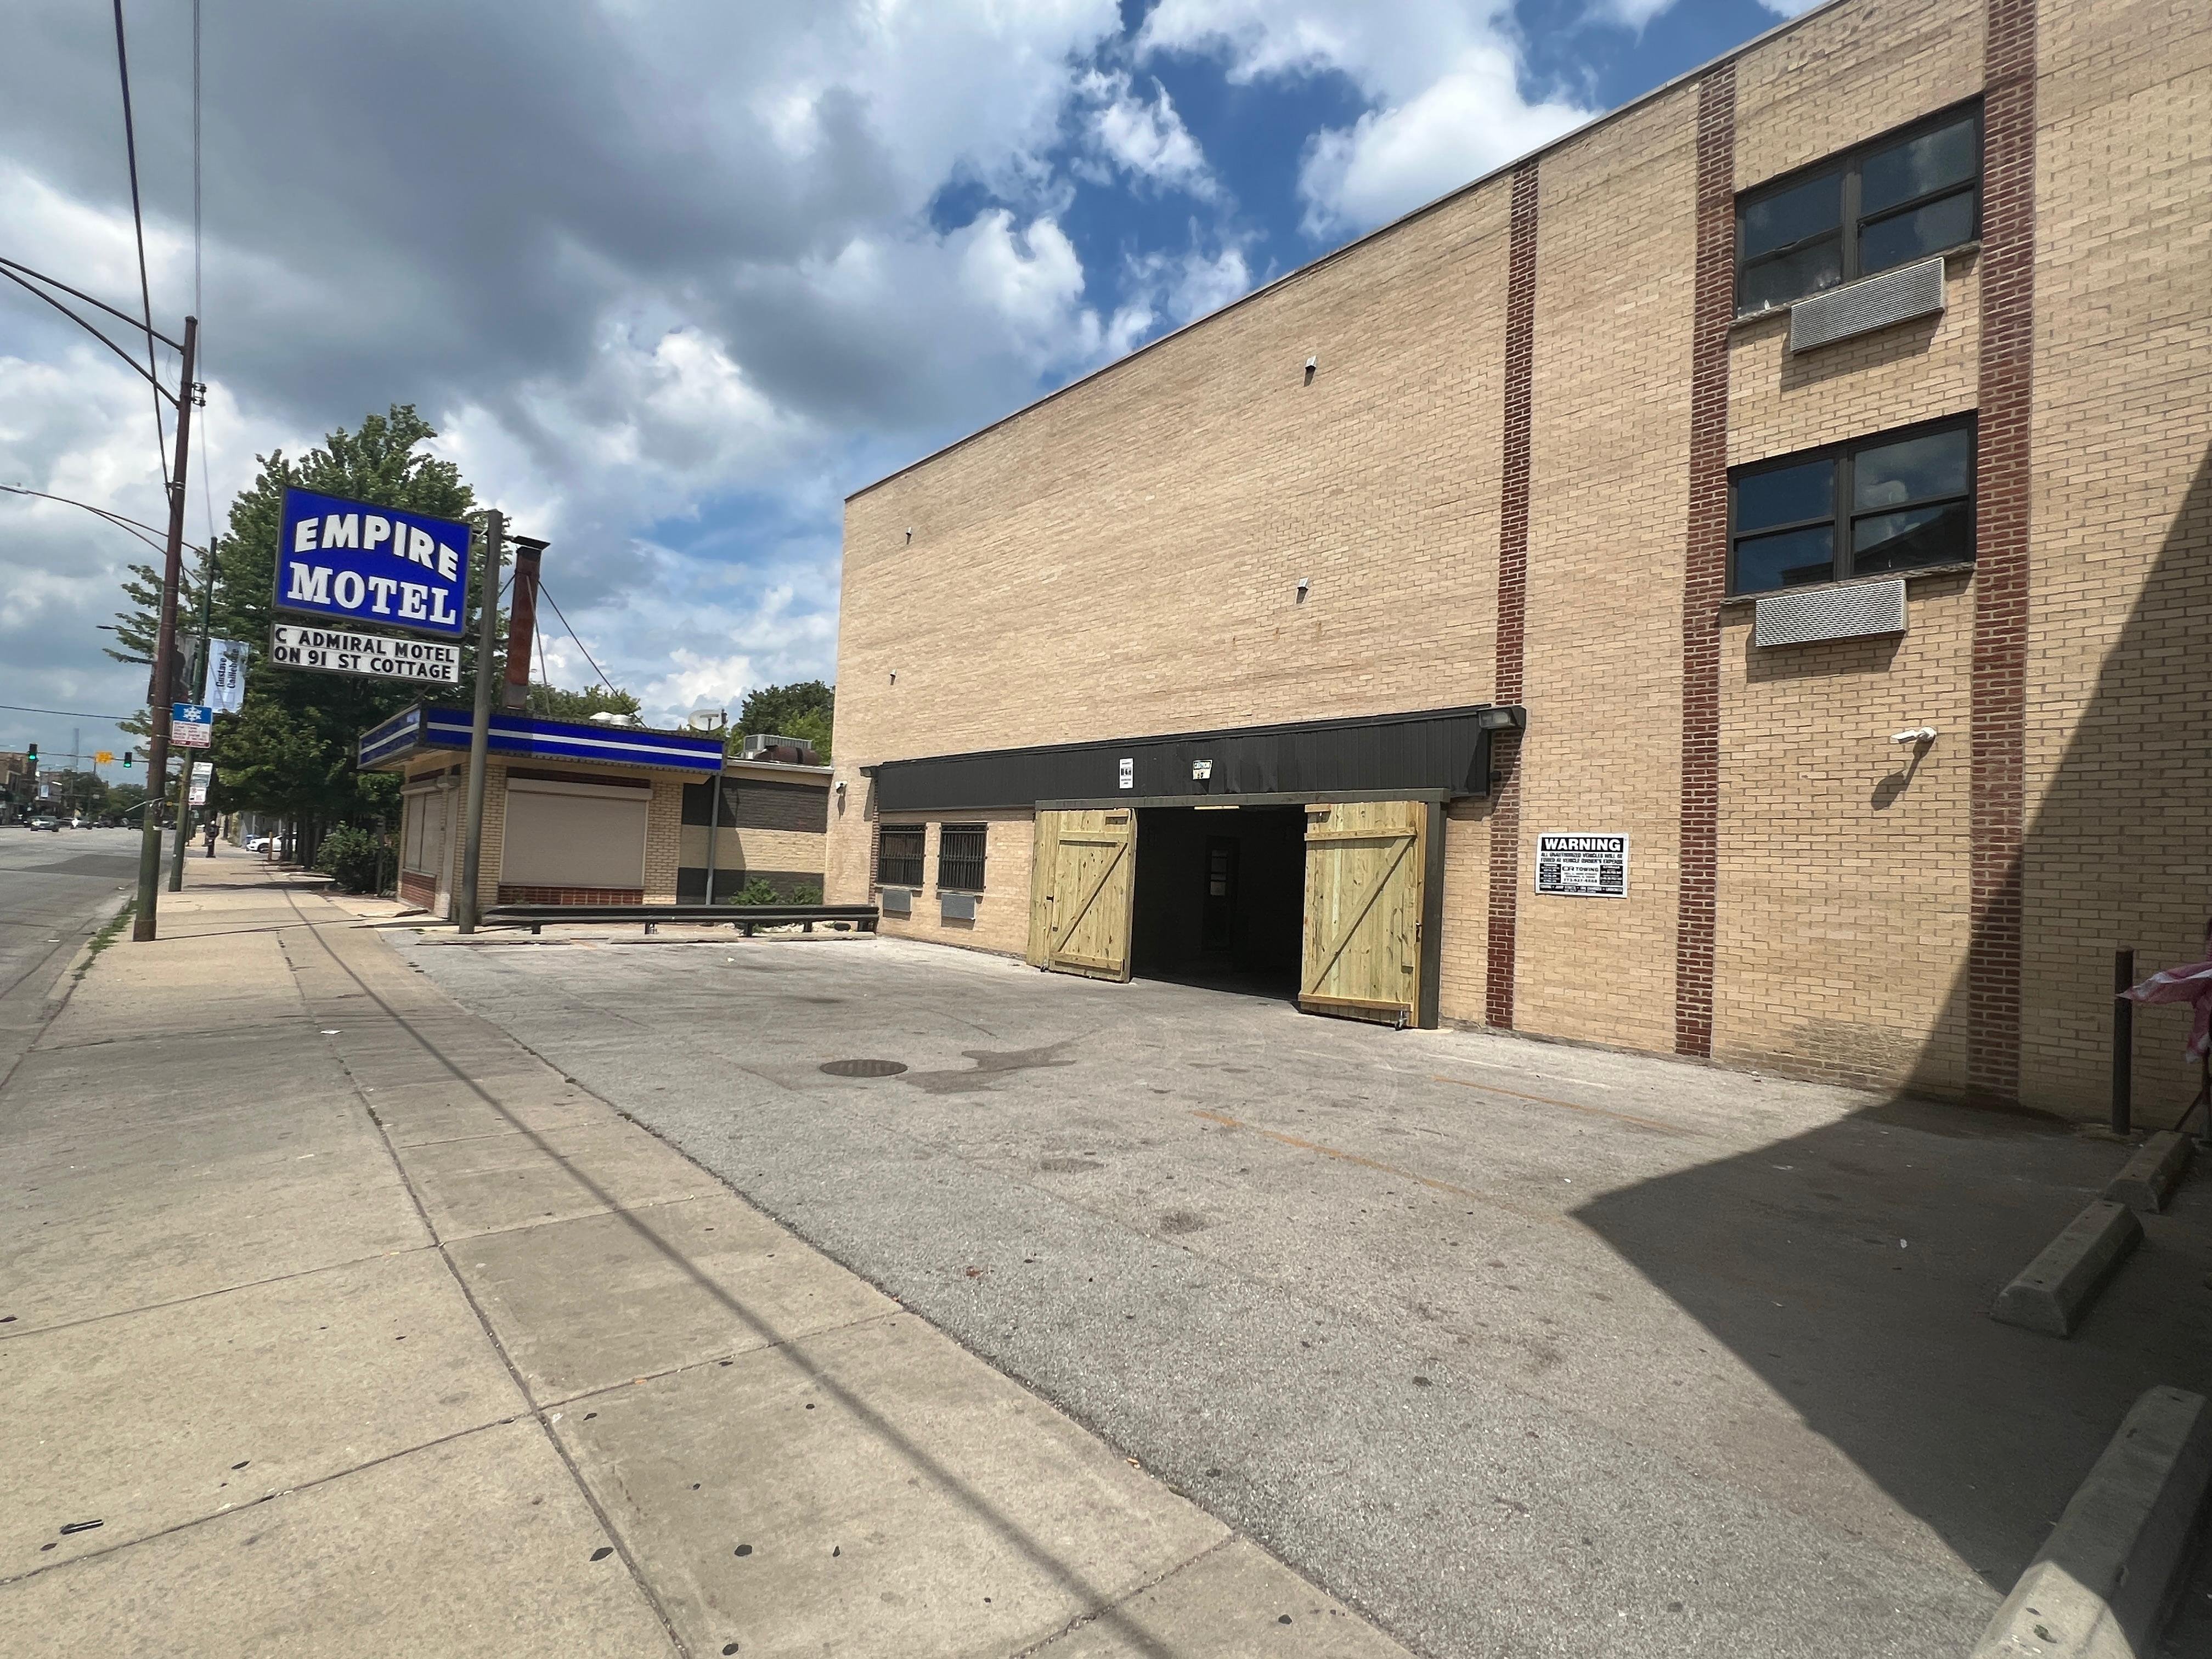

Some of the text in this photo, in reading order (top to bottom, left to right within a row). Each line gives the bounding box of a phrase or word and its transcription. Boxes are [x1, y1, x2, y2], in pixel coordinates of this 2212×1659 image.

[295, 514, 459, 582] EMPIRE
[287, 561, 456, 625] MOTEL
[274, 646, 452, 679] ON 91 ST COTTAGE
[275, 628, 454, 663] C ADMIRAL MOTEL
[1544, 838, 1621, 851] WARNING
